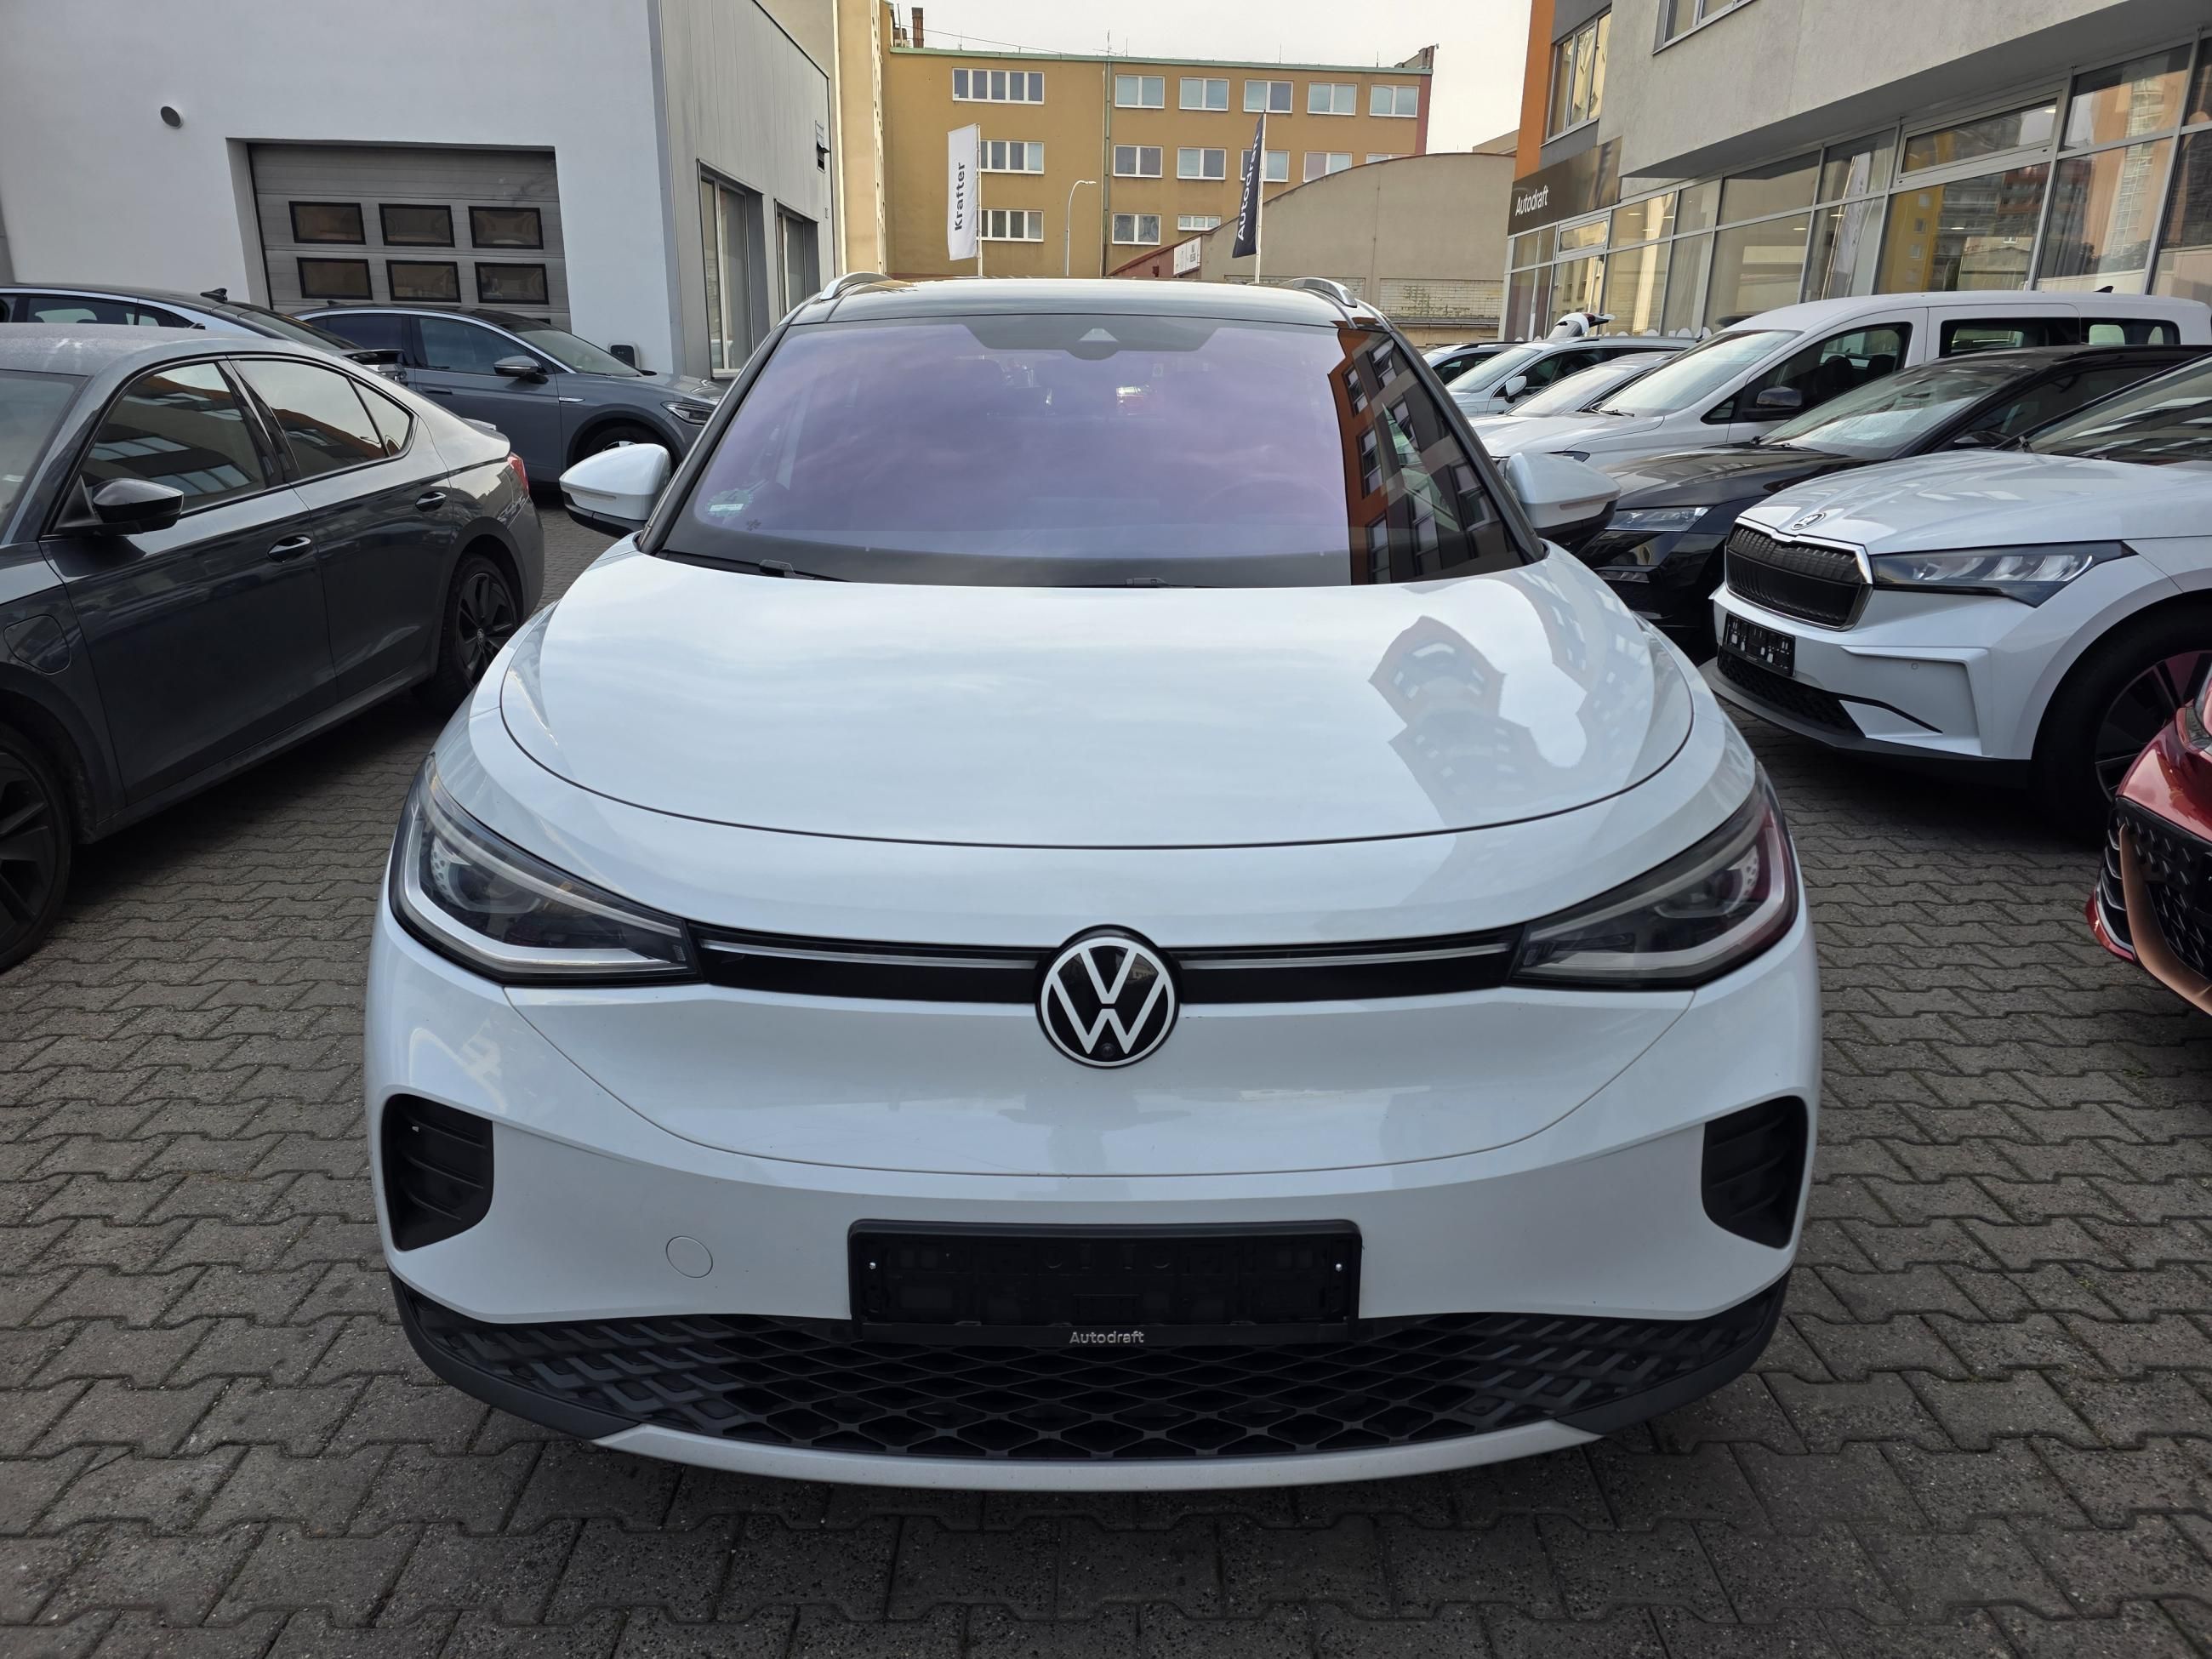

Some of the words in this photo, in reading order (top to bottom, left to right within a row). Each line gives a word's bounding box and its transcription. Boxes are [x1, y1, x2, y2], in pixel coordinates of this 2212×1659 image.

[955, 162, 966, 231] Krafter
[1515, 185, 1548, 217] Autodraft
[1043, 939, 1172, 1060] VW
[1069, 1331, 1144, 1344] Autodraft
